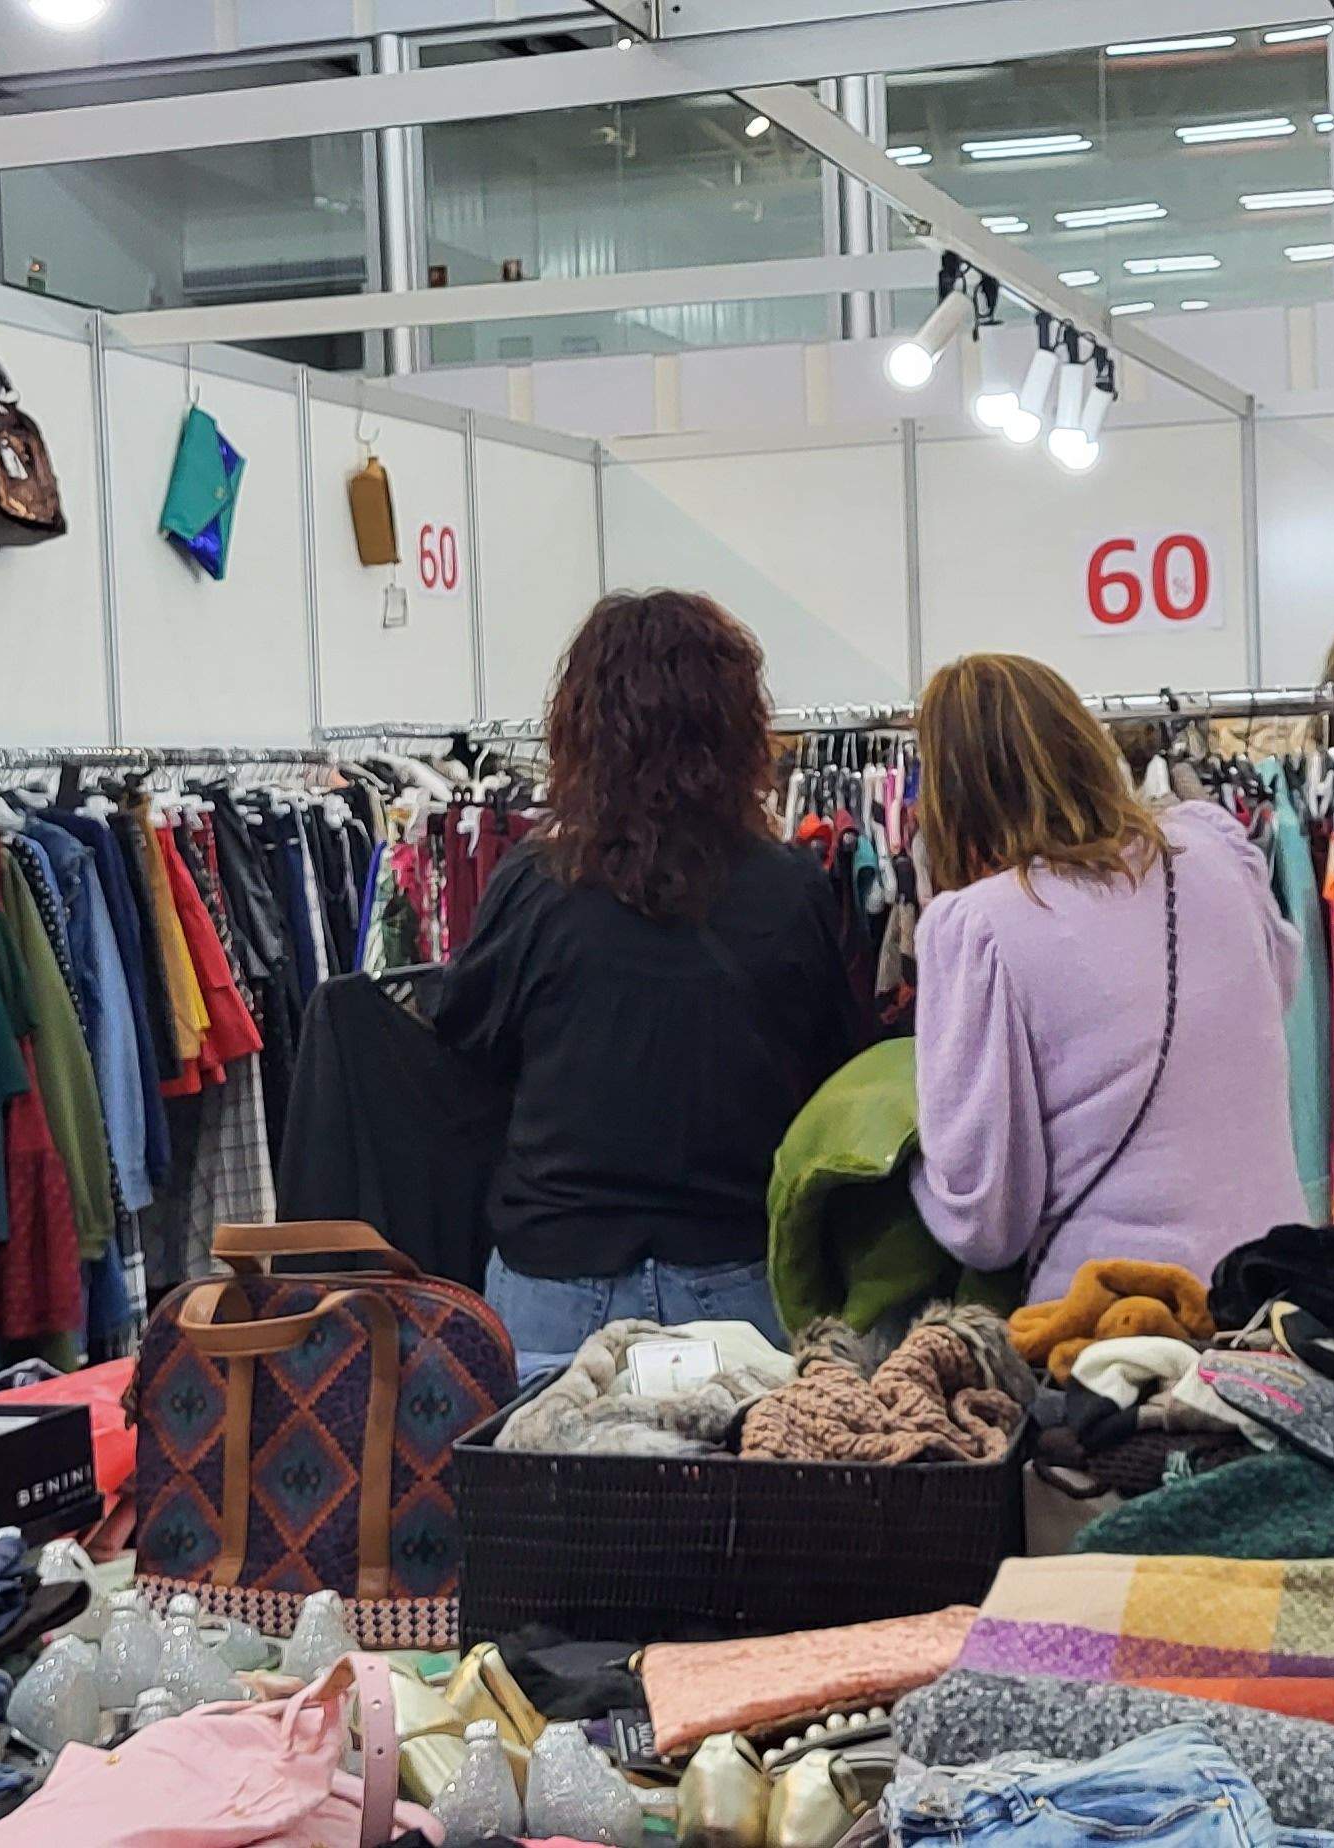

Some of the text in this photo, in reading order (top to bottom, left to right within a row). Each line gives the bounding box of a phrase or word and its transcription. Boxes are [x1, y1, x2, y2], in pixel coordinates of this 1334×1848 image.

[420, 524, 456, 590] 60
[1088, 535, 1208, 624] 60
[16, 1464, 92, 1509] BENINI
